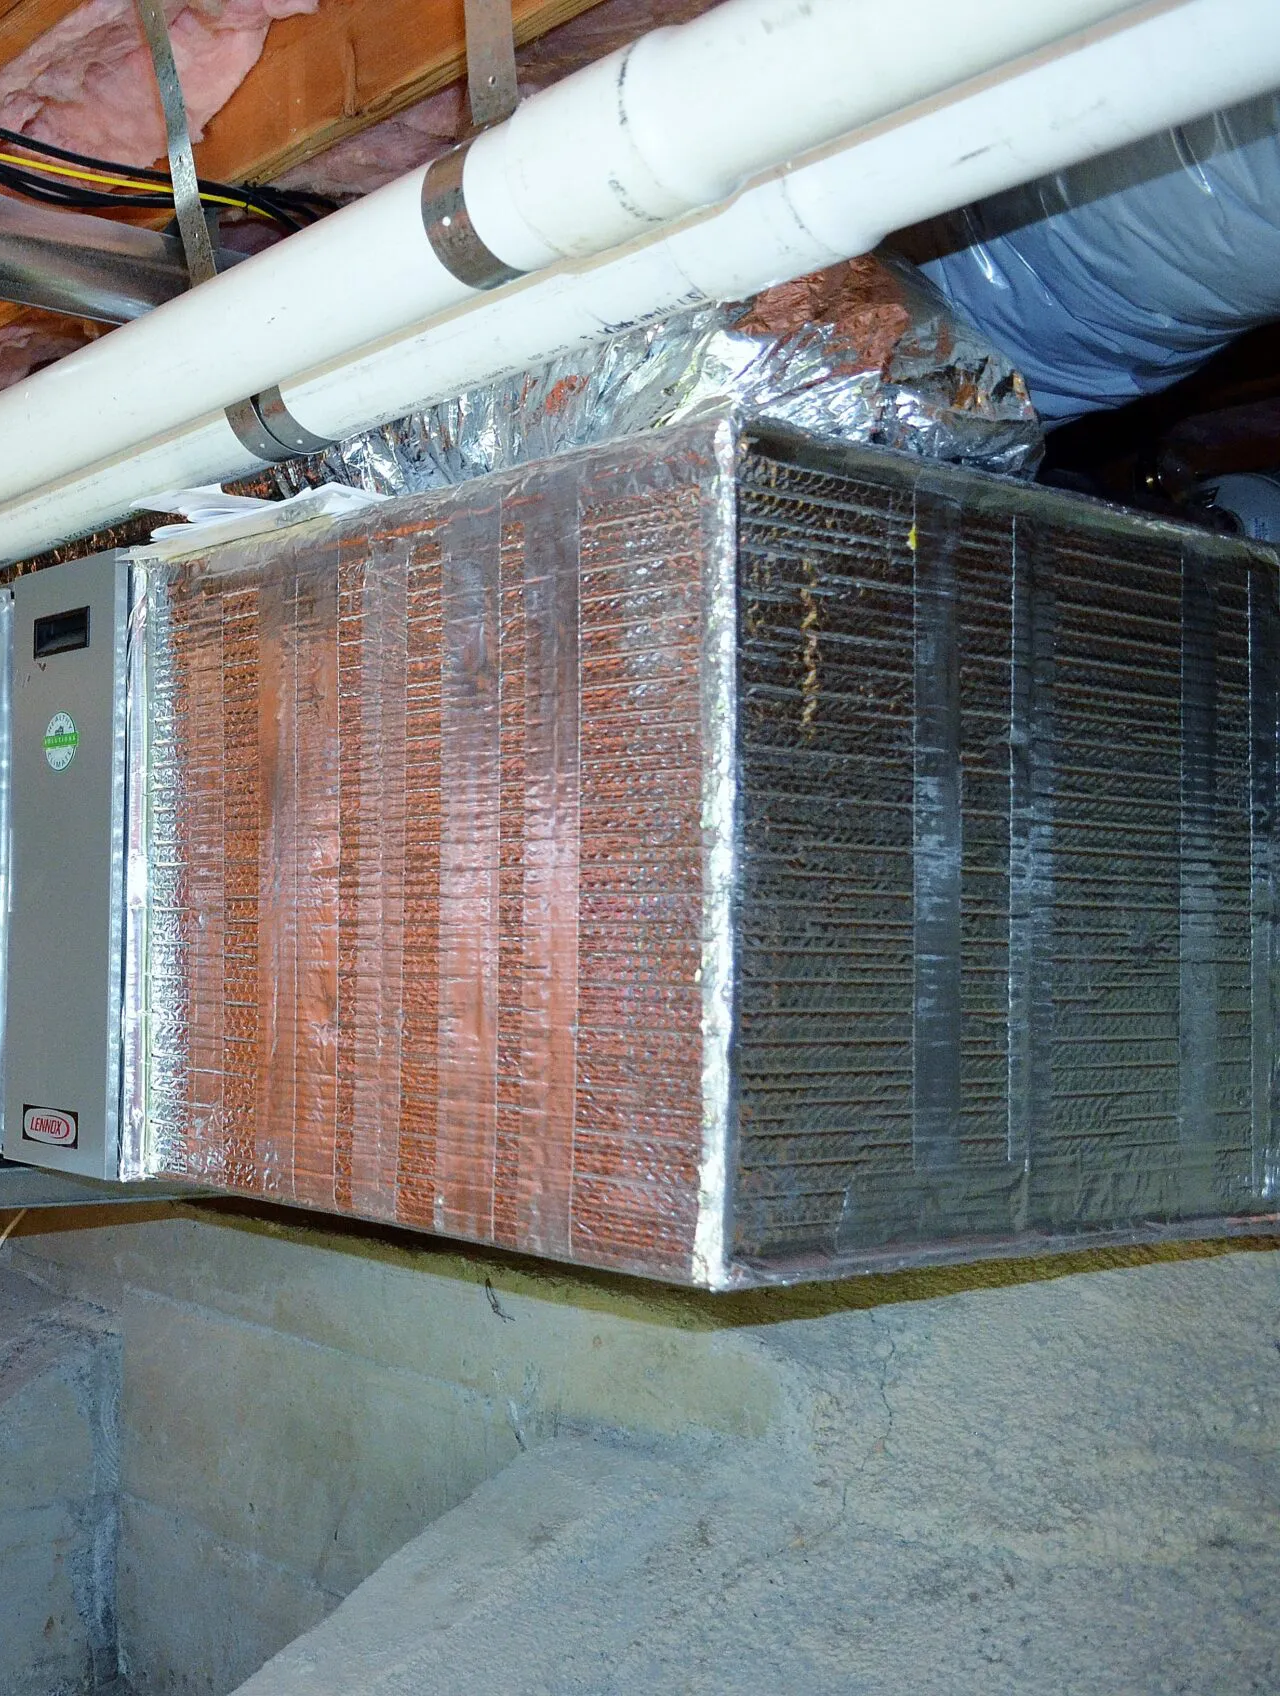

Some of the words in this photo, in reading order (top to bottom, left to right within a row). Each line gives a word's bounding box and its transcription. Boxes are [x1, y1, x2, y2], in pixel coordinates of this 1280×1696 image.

[47, 714, 73, 732] HEALTHY
[44, 735, 76, 745] SOLUTIONS
[47, 751, 72, 768] CLIMATE
[30, 1116, 63, 1136] LENNOX
